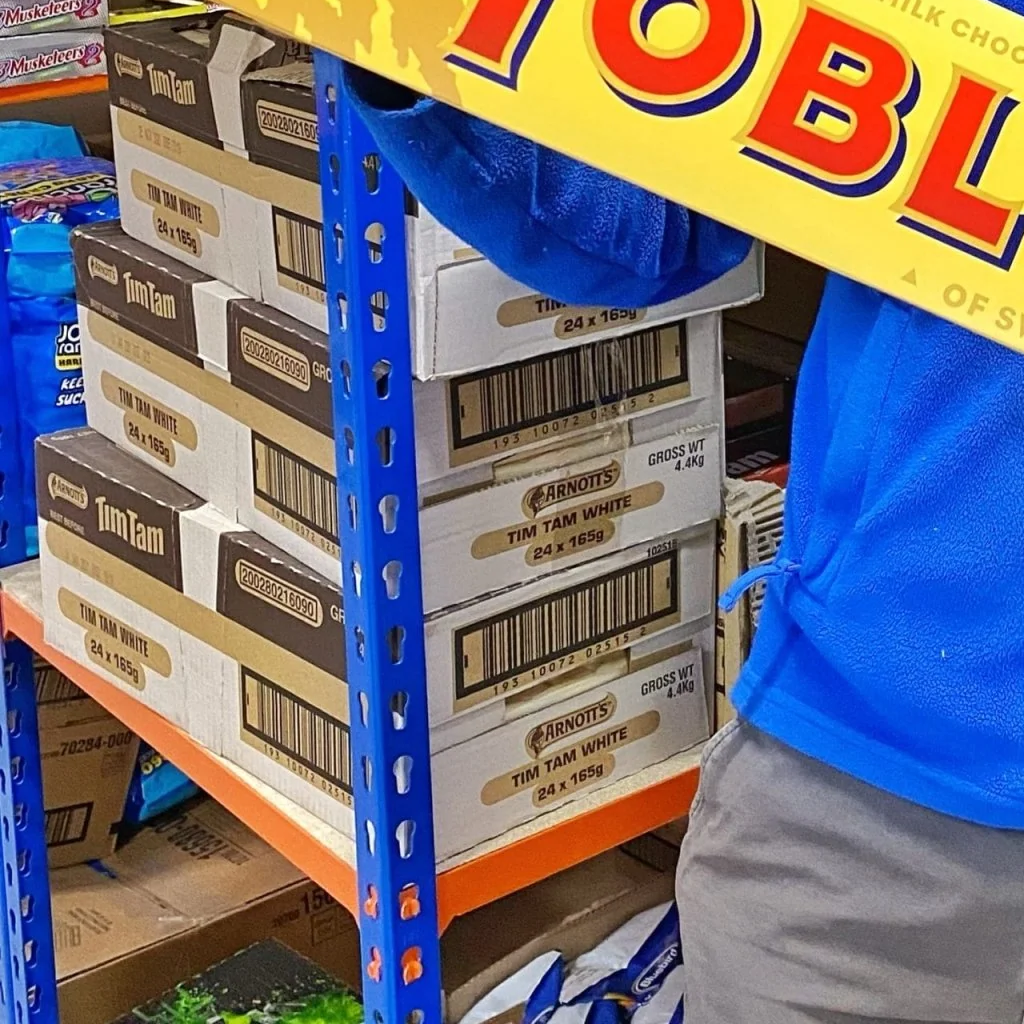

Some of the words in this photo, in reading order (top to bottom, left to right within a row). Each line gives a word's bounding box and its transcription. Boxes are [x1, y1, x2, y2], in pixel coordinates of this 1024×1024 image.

[11, 46, 85, 76] Musketeers
[147, 183, 161, 205] TIM
[162, 191, 177, 211] TAM
[179, 197, 203, 224] WHITE
[157, 219, 168, 233] 24
[169, 226, 175, 239] x
[177, 228, 197, 253] 165g
[943, 283, 990, 316] OF
[564, 317, 583, 332] 24
[585, 316, 596, 327] x
[600, 308, 638, 324] 165g
[244, 337, 307, 380] 200280216090
[118, 386, 133, 408] TIM
[135, 396, 151, 419] TAM
[152, 404, 178, 435] WHITE
[493, 436, 520, 449] 193
[533, 416, 580, 438] 10072
[648, 393, 655, 403] 2
[128, 422, 140, 439] 24
[141, 431, 147, 445] x
[149, 434, 170, 462] 165g
[648, 446, 683, 467] GROSS
[685, 438, 705, 455] WT
[674, 454, 706, 472] 4.4Kg
[545, 466, 616, 502] ARNOTT'S
[507, 527, 538, 545] TIM
[542, 513, 577, 535] TAM
[582, 495, 632, 522] WHITE
[533, 544, 552, 560] 24
[555, 544, 565, 554] x
[569, 530, 605, 549] 165g
[242, 568, 314, 617] 200280216090
[80, 602, 97, 626] TIM
[99, 614, 118, 639] TAM
[120, 625, 149, 658] WHITE
[91, 639, 104, 658] 24
[105, 649, 112, 664] x
[115, 653, 139, 684] 165g
[493, 678, 519, 697] 193
[531, 656, 575, 679] 10072
[586, 633, 631, 658] 02515
[640, 627, 647, 636] 2
[641, 672, 675, 696] GROSS
[676, 664, 695, 685] WT
[666, 681, 695, 700] 4.4Kg
[545, 700, 608, 742] ARNOTT'S
[263, 744, 280, 760] 193
[286, 758, 316, 782] 10072
[512, 766, 539, 788] TIM
[544, 749, 577, 778] TAM
[581, 727, 629, 758] WHITE
[537, 784, 556, 801] 24
[559, 781, 567, 792] x
[570, 764, 604, 784] 165g
